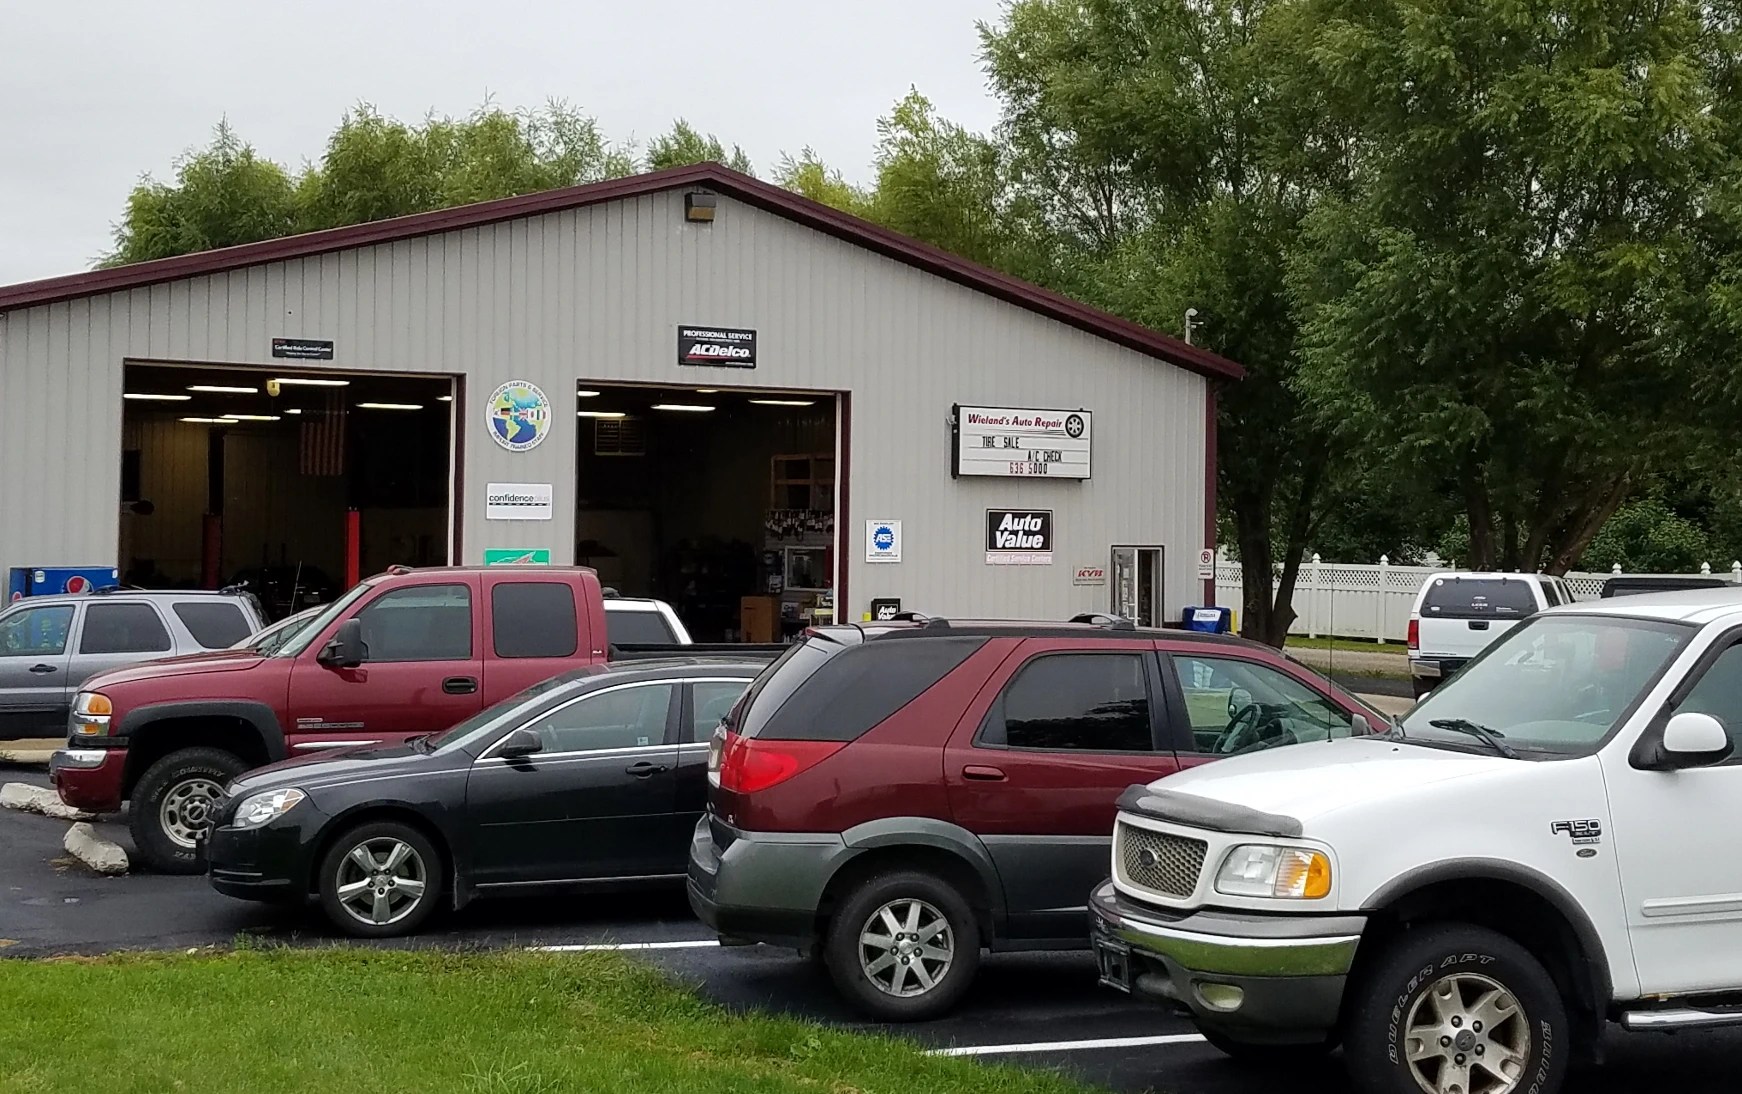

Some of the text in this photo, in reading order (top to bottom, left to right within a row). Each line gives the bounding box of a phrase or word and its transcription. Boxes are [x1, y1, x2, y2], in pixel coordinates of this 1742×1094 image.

[683, 330, 727, 338] PROFESSIONAL
[728, 332, 753, 340] SERVICE
[689, 343, 750, 357] ACDelco
[967, 413, 1063, 430] Wieland's Auto Repair
[982, 436, 1020, 449] TIRE SALE
[1027, 451, 1063, 463] A/C CHECK
[1009, 462, 1048, 475] 636 5000
[489, 494, 534, 502] confidence
[998, 513, 1043, 531] Auto
[876, 533, 892, 543] ASE
[995, 531, 1044, 549] Value
[878, 606, 897, 614] Auto
[878, 612, 896, 621] Valu
[1388, 953, 1496, 1065] DUELER APT
